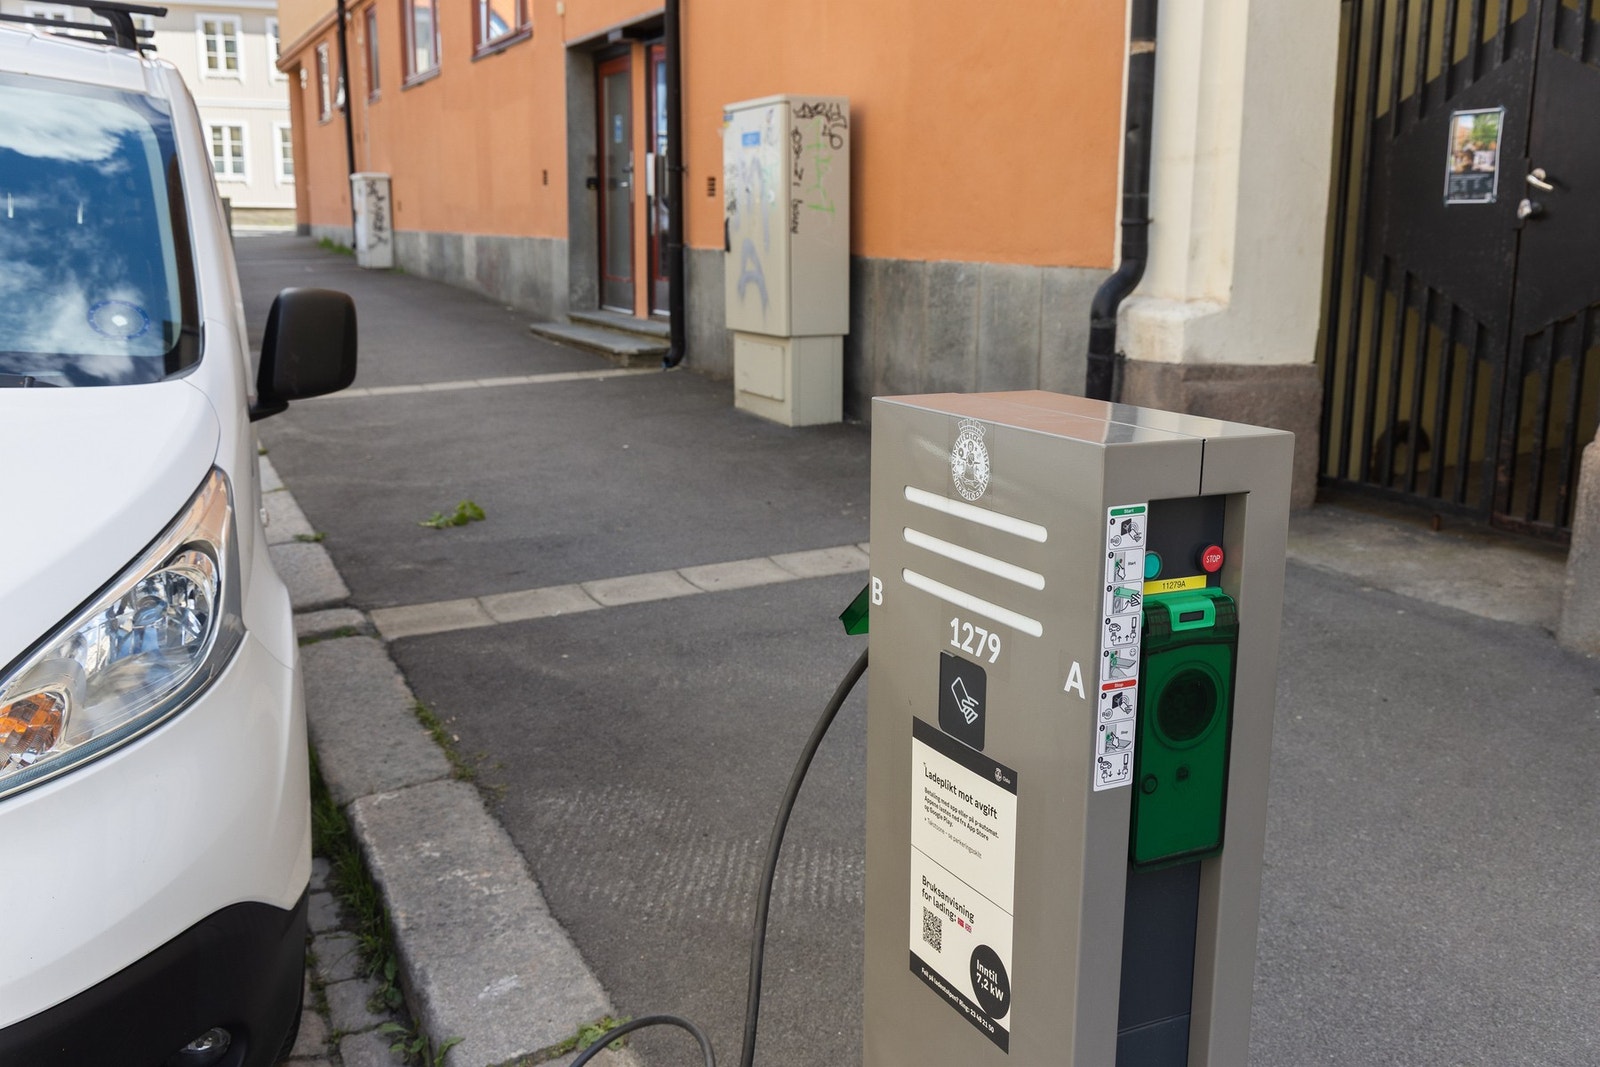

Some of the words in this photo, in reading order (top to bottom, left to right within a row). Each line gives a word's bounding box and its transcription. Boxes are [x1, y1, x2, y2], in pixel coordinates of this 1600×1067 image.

[1206, 554, 1220, 564] STOP
[872, 576, 883, 606] B
[1162, 580, 1186, 590] 11279A
[950, 617, 1001, 664] 1279
[1064, 661, 1086, 700] A
[924, 766, 957, 795] Ladeplikt
[958, 790, 973, 805] mot
[975, 800, 998, 819] avgift
[924, 787, 941, 803] Betaling
[941, 799, 950, 808] med
[958, 810, 968, 819] eller
[924, 796, 938, 809] Appene
[967, 823, 975, 833] App
[976, 828, 989, 841] Store
[930, 807, 943, 820] Google
[922, 875, 974, 924] Bruksanvisning
[922, 888, 932, 902] for
[932, 896, 956, 922] lading:
[976, 959, 998, 984] Inntil
[976, 972, 989, 990] 7,2
[990, 983, 1004, 1002] kW
